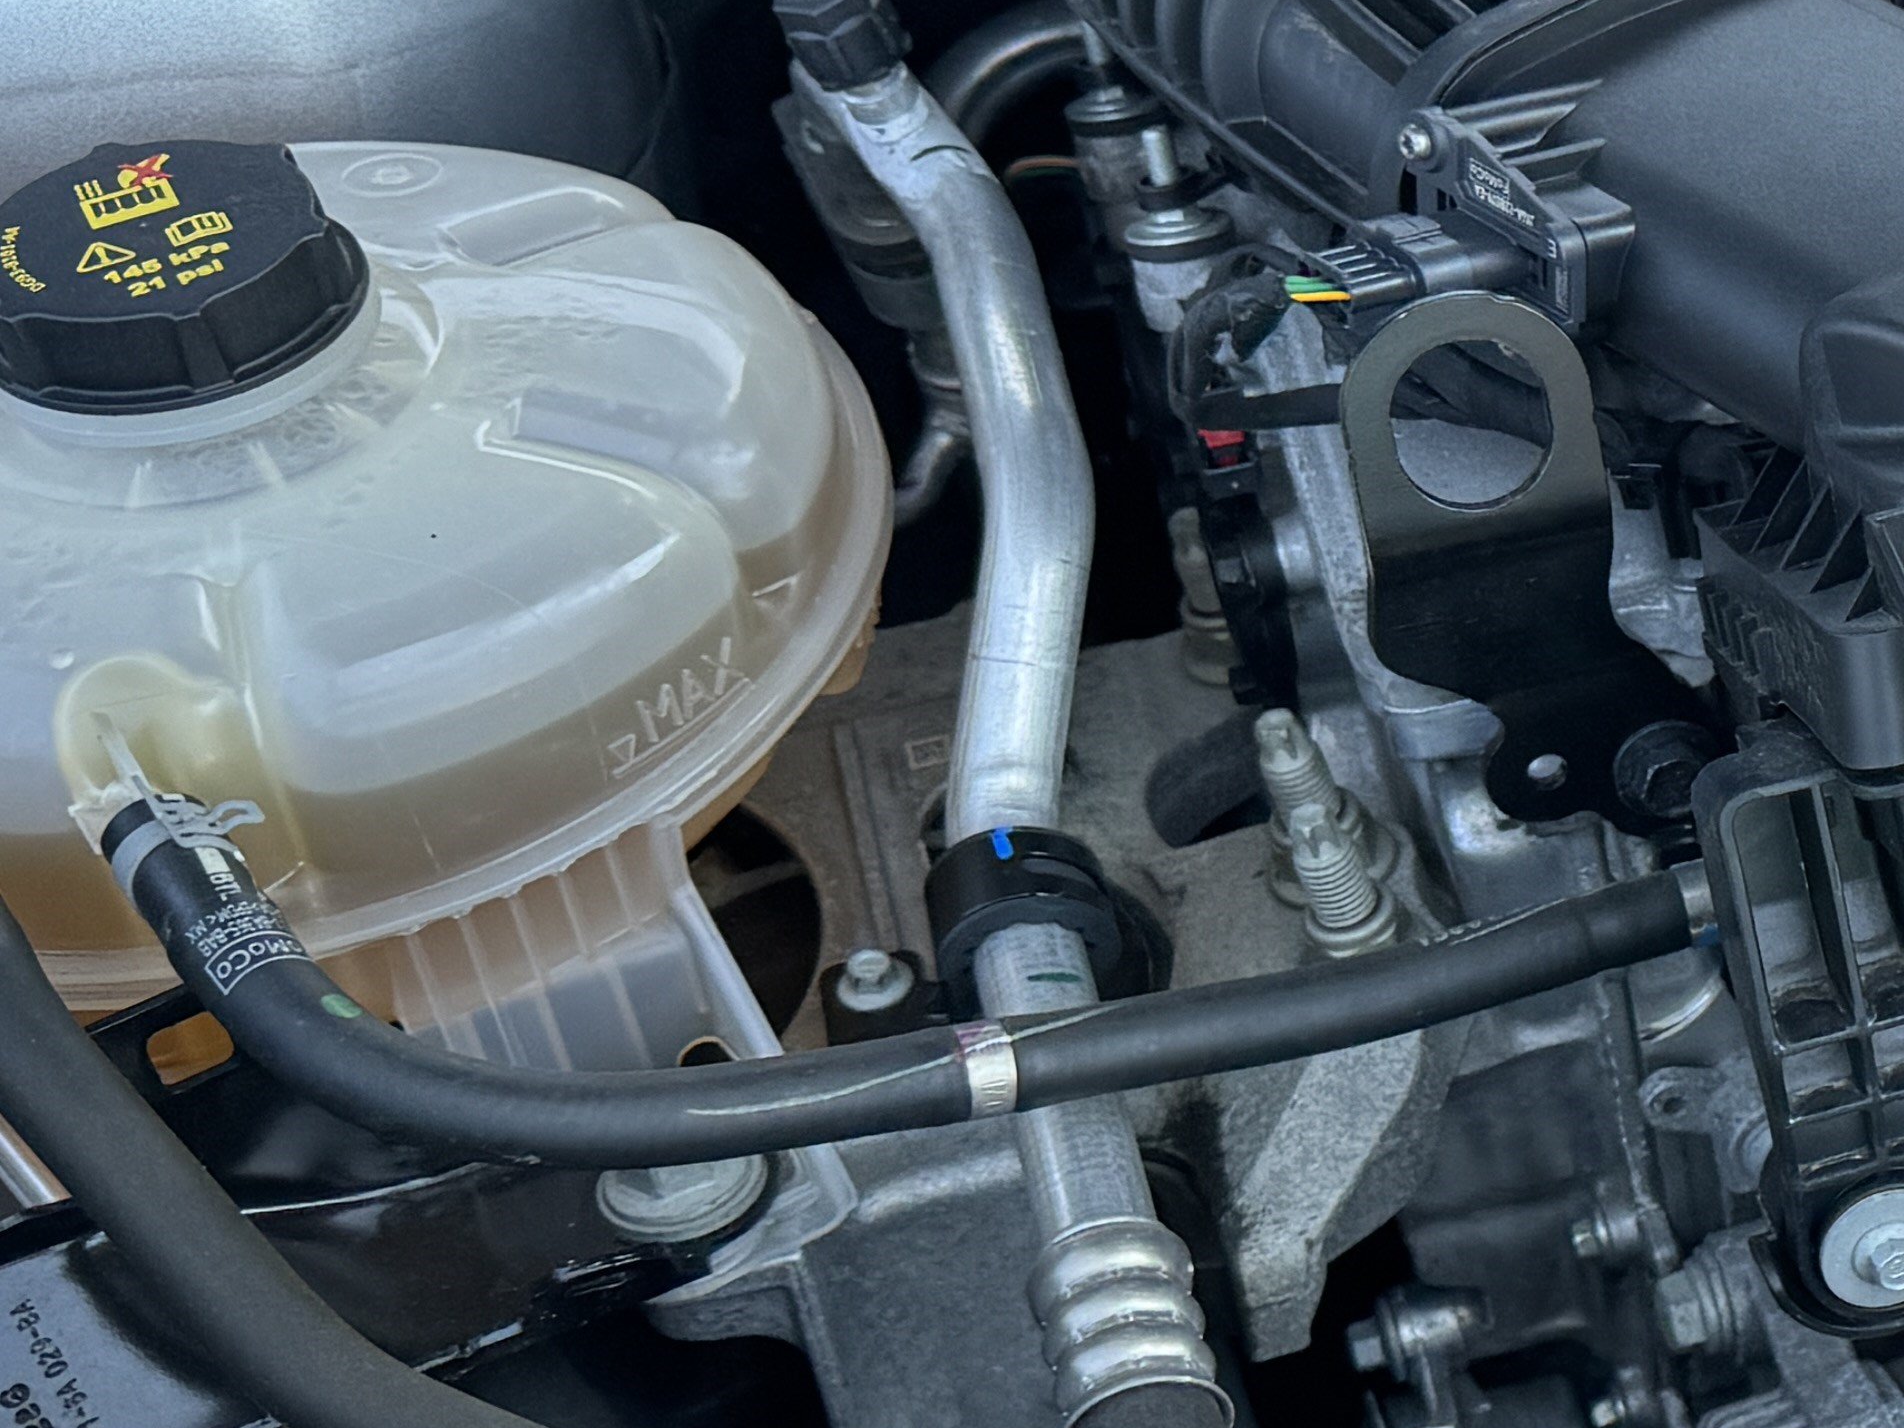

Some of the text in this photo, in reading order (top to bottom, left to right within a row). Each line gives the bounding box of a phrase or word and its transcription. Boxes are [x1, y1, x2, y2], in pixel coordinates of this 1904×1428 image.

[103, 241, 231, 285] 145 kPa
[127, 258, 225, 298] 21 psi
[636, 636, 746, 743] MAX
